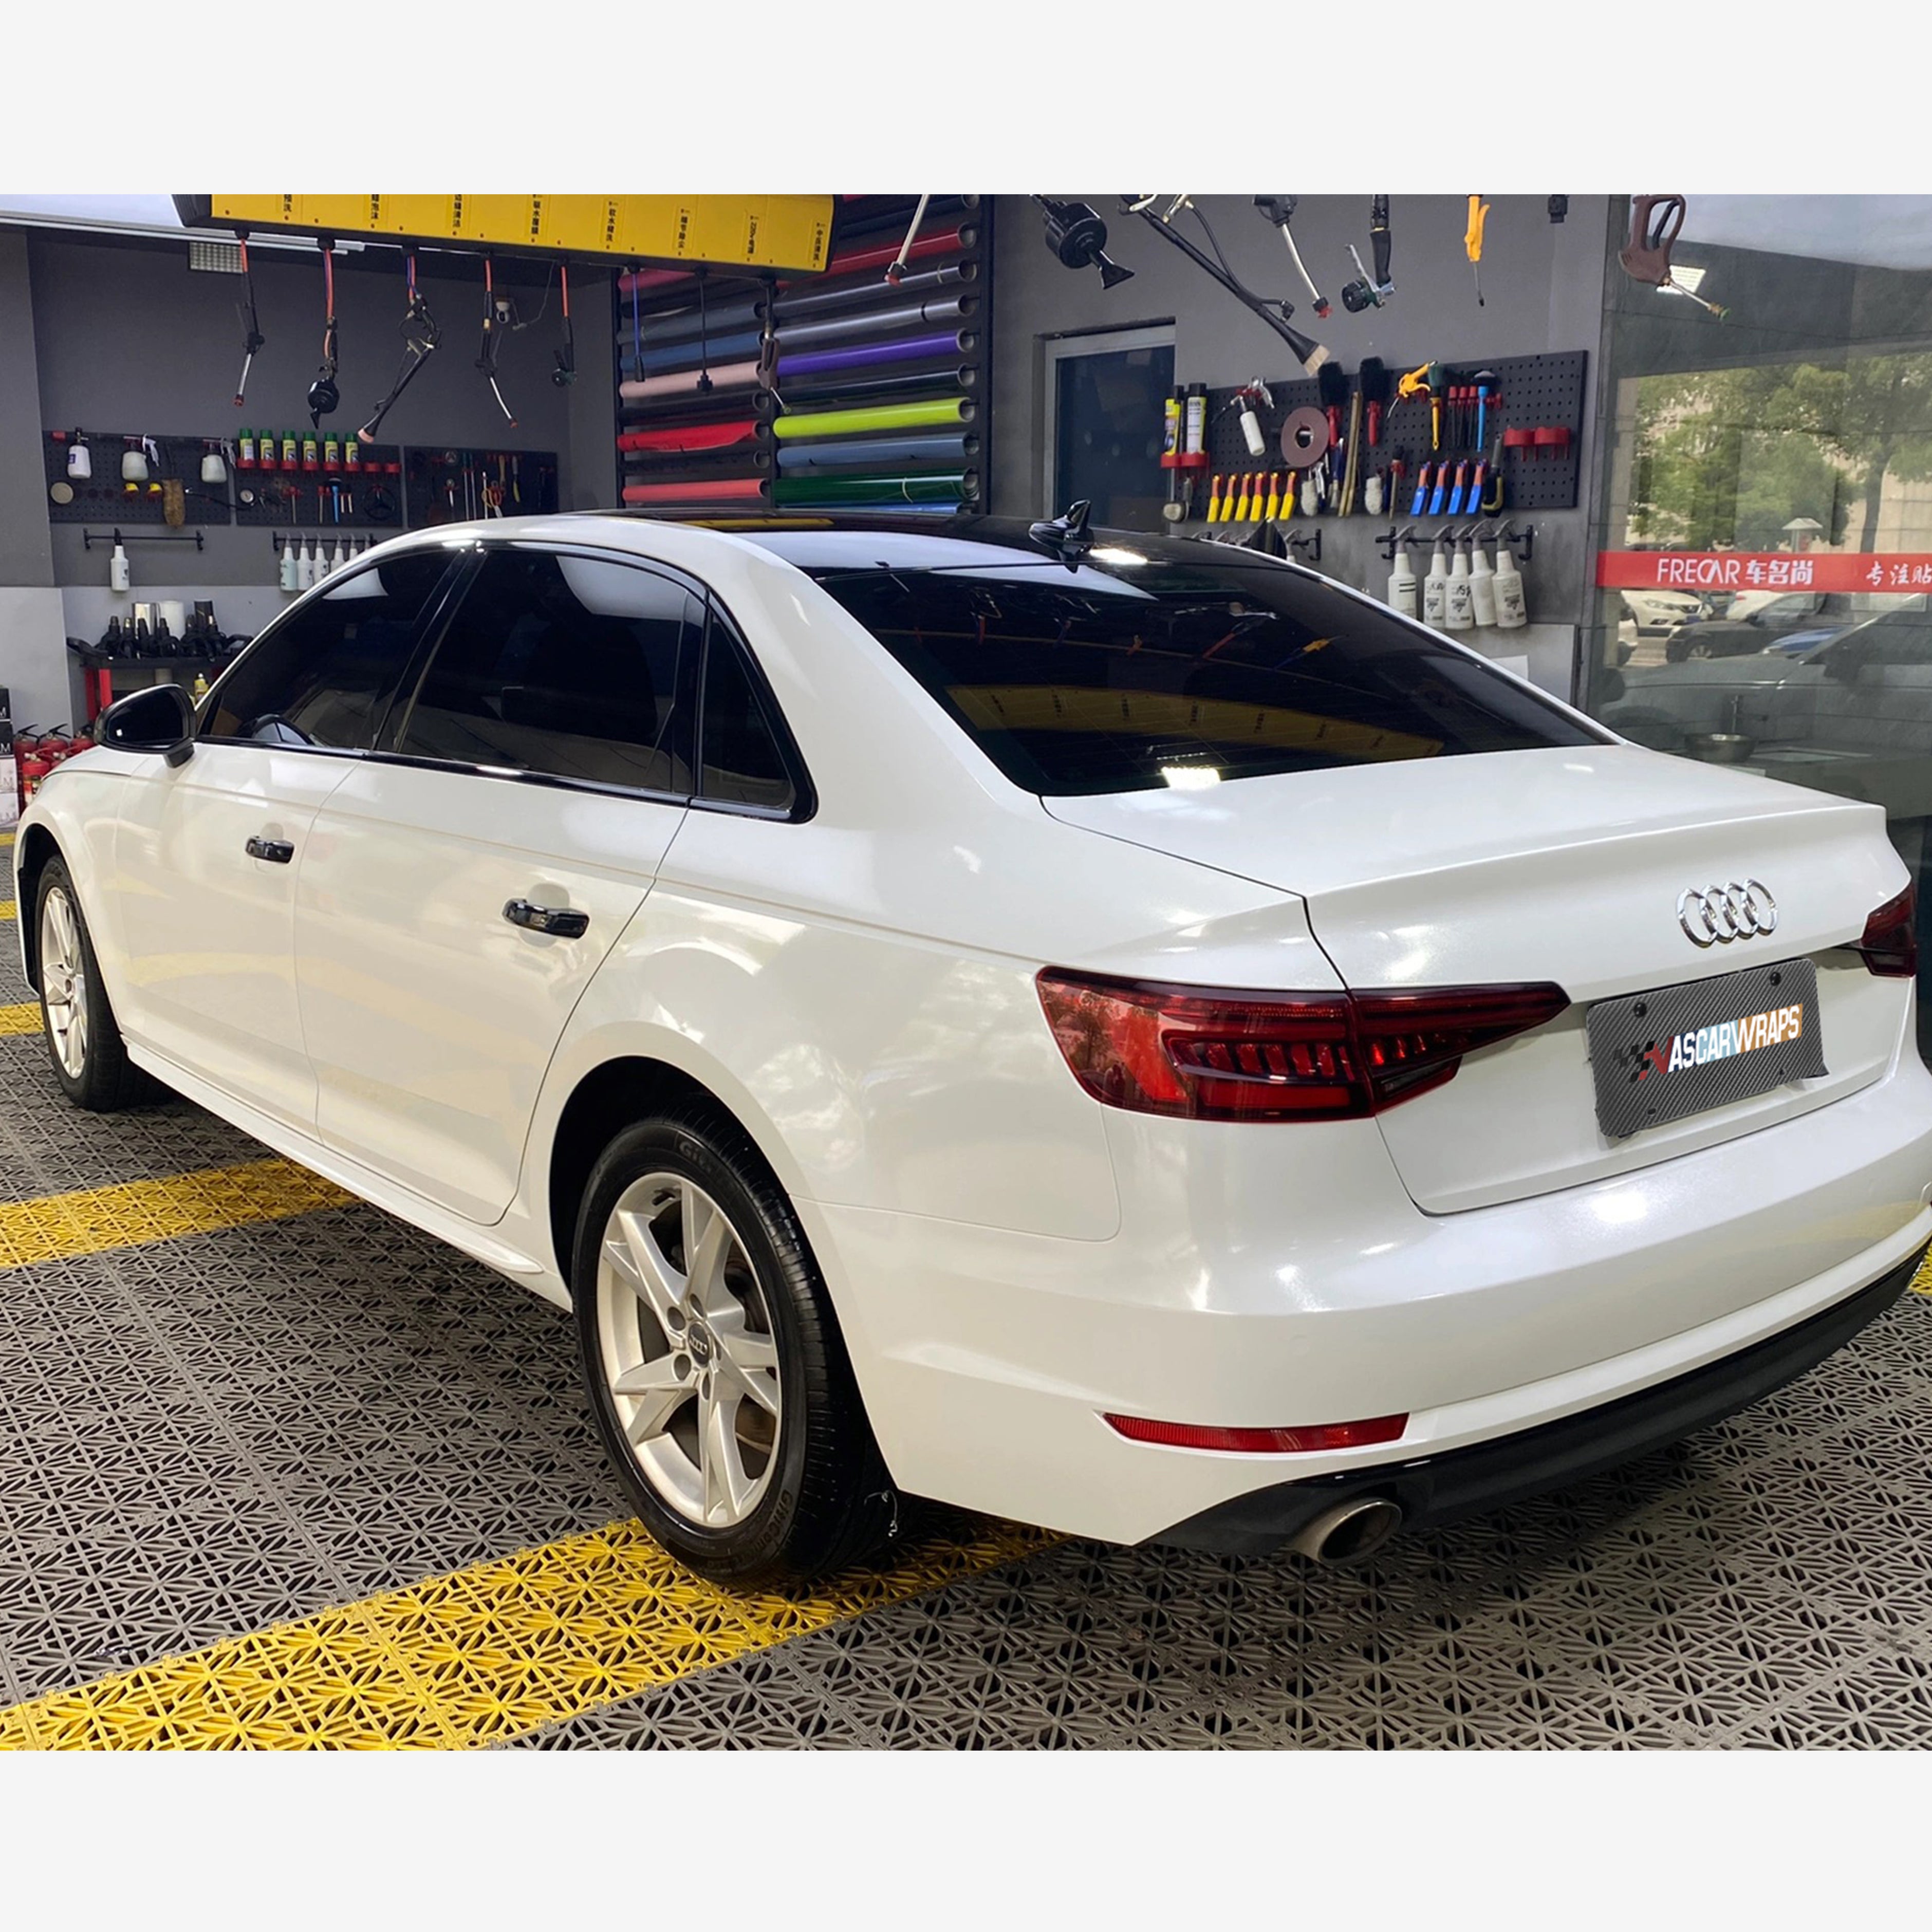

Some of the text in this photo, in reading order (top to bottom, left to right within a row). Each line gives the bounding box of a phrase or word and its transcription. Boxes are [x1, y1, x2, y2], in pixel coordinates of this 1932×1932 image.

[1657, 558, 1814, 585] FRECAR 车名尚
